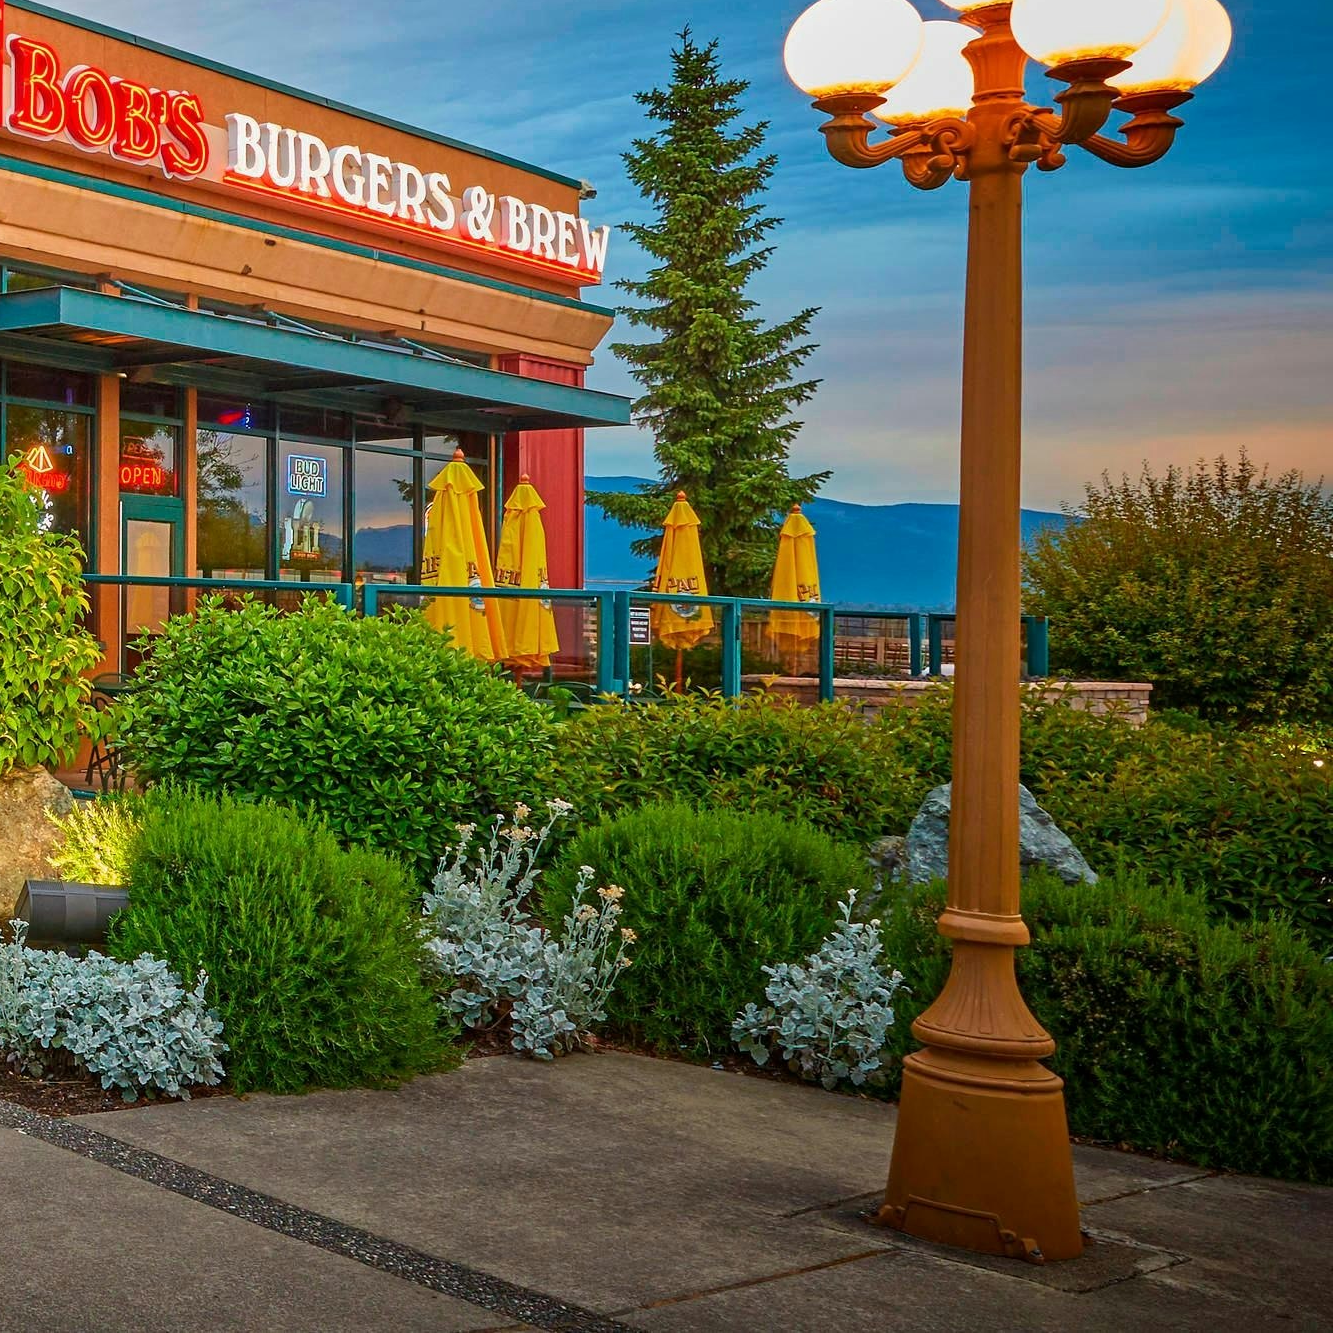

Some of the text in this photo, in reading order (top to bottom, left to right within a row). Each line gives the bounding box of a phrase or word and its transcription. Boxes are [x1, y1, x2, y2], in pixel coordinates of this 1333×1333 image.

[6, 33, 611, 273] BOB'S BURGERS & BREW
[121, 467, 161, 485] OPEN
[295, 459, 320, 476] BUD
[290, 474, 324, 493] LIGHT
